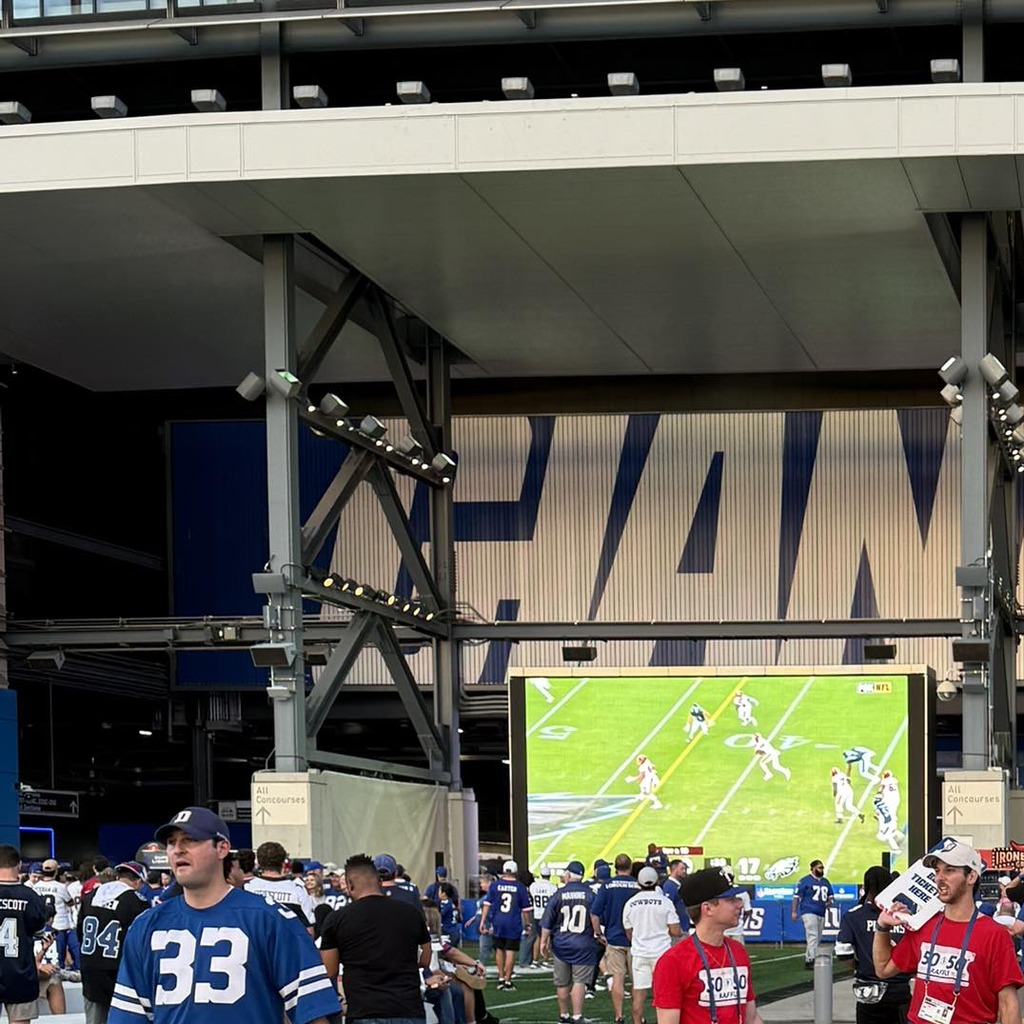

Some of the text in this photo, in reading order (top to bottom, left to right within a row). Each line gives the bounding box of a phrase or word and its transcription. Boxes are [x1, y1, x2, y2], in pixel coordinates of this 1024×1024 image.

[256, 786, 269, 795] All
[948, 785, 961, 794] All
[256, 796, 306, 805] Concourses
[947, 795, 1000, 804] Concourses
[738, 857, 761, 875] 17
[911, 873, 939, 896] TICKET
[501, 892, 512, 913] 3
[908, 885, 932, 903] HERE
[559, 904, 587, 934] 10
[80, 915, 122, 959] 84
[151, 926, 249, 1006] 33
